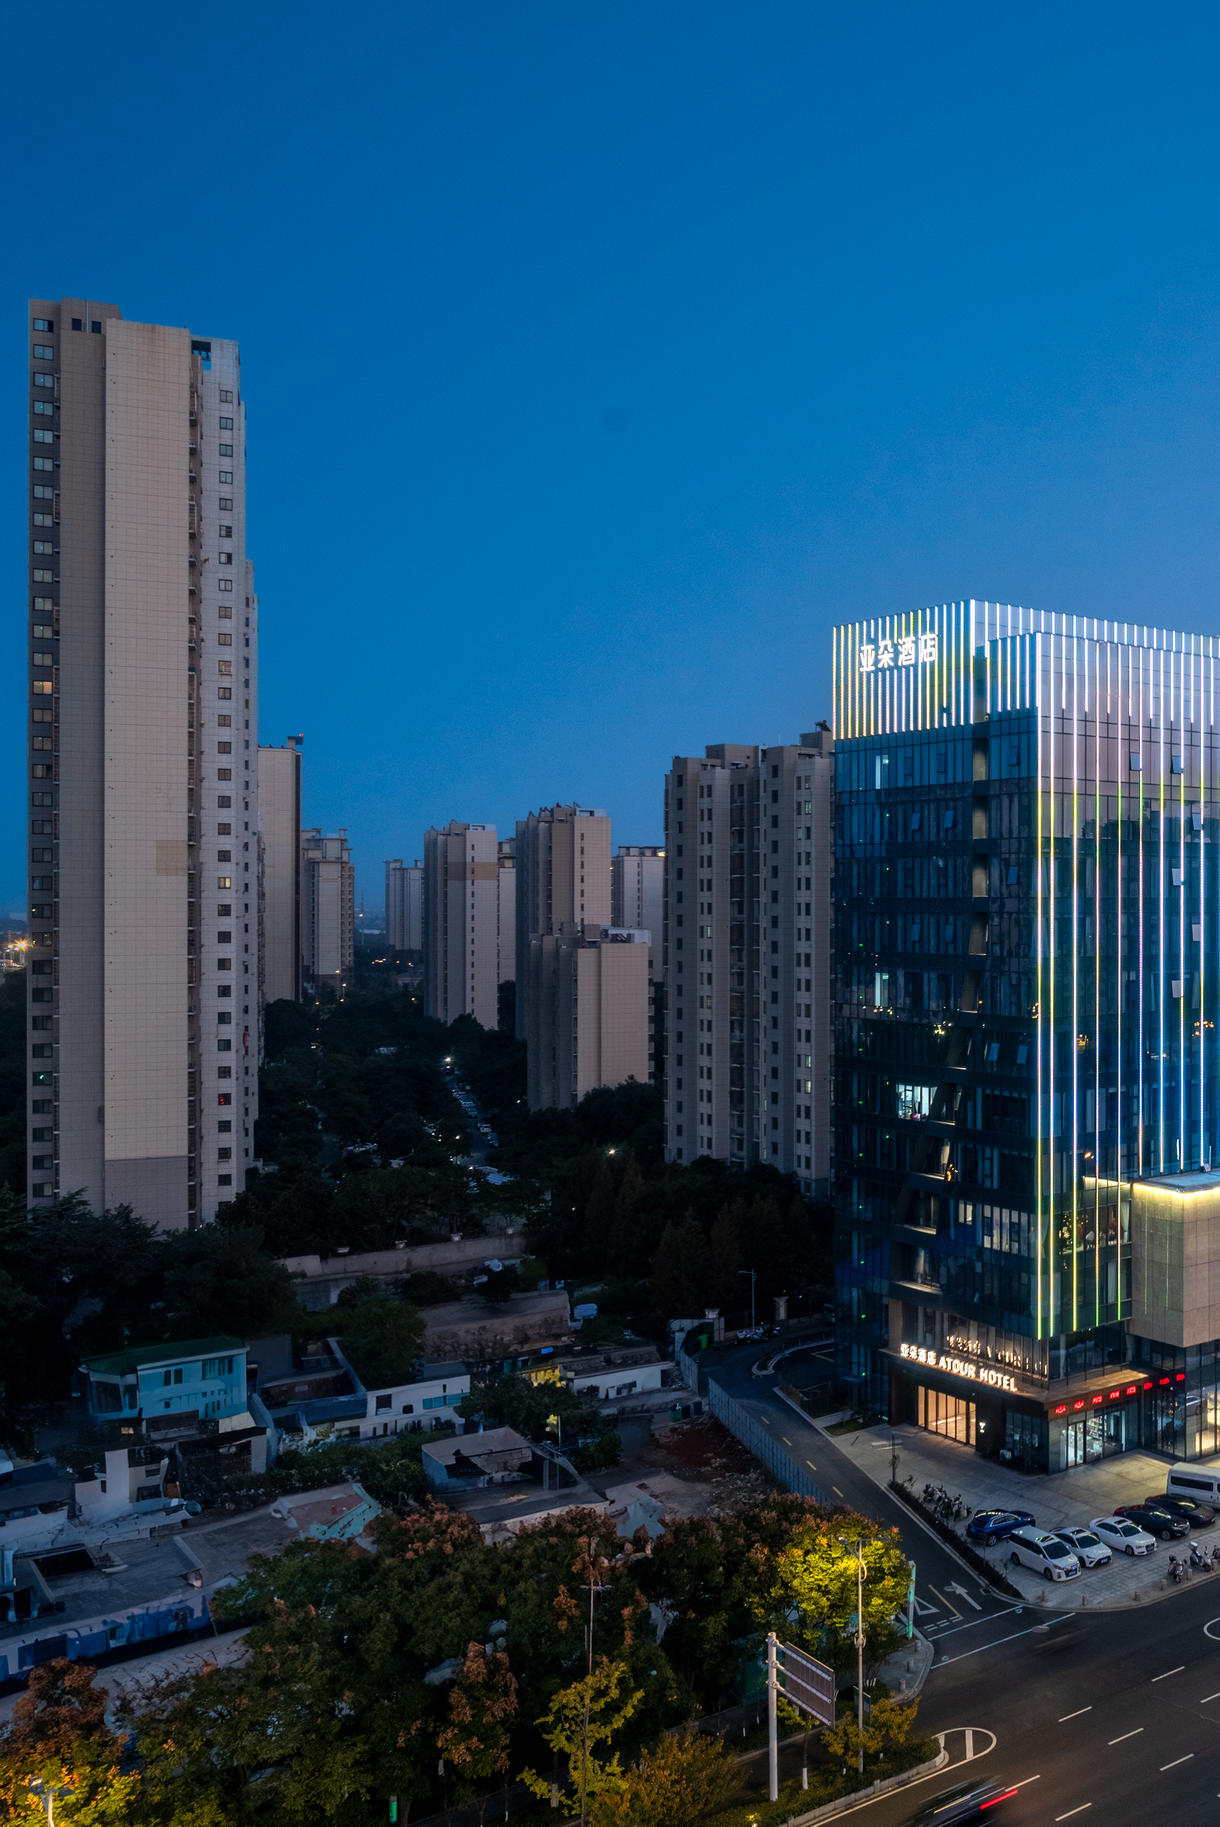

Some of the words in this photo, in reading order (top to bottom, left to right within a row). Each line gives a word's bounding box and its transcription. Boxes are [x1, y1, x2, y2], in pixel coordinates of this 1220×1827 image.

[859, 632, 938, 672] 亚朵酒店
[900, 1343, 937, 1367] 亚朵酒店
[938, 1355, 977, 1379] ATOUR
[979, 1367, 1018, 1392] HOTEL
